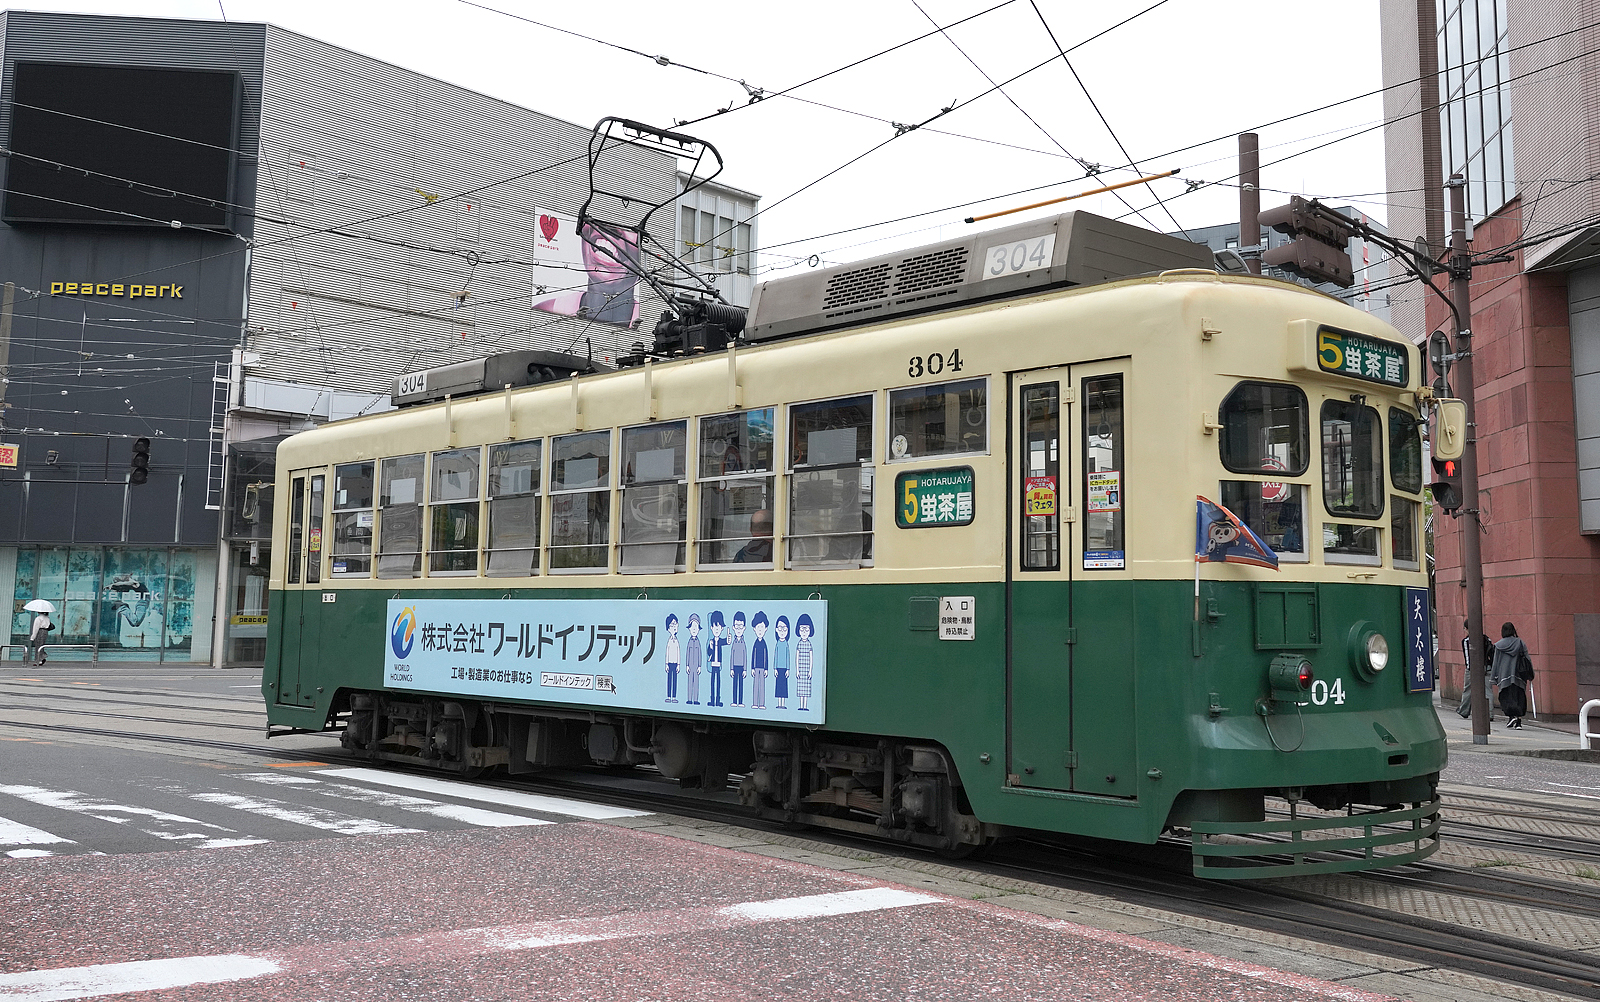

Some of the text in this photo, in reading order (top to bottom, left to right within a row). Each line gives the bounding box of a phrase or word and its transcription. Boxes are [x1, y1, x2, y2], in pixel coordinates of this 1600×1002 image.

[991, 238, 1046, 276] 304
[50, 282, 184, 298] peace park
[1319, 331, 1344, 369] 5
[1347, 337, 1397, 356] HOTARUJAYA
[908, 348, 964, 378] 304
[1345, 346, 1401, 383] 蛍茶屋
[401, 375, 424, 394] 304
[921, 475, 972, 487] HOTARUJAYA
[904, 480, 918, 524] 5
[920, 491, 972, 522] 蛍茶屋
[394, 663, 410, 672] WORLD
[450, 667, 533, 684] 工場・製造業のお仕事なら
[390, 673, 413, 682] HOLDINGS
[542, 674, 611, 689] ワールドインテック 検索
[1294, 677, 1346, 706] 04
